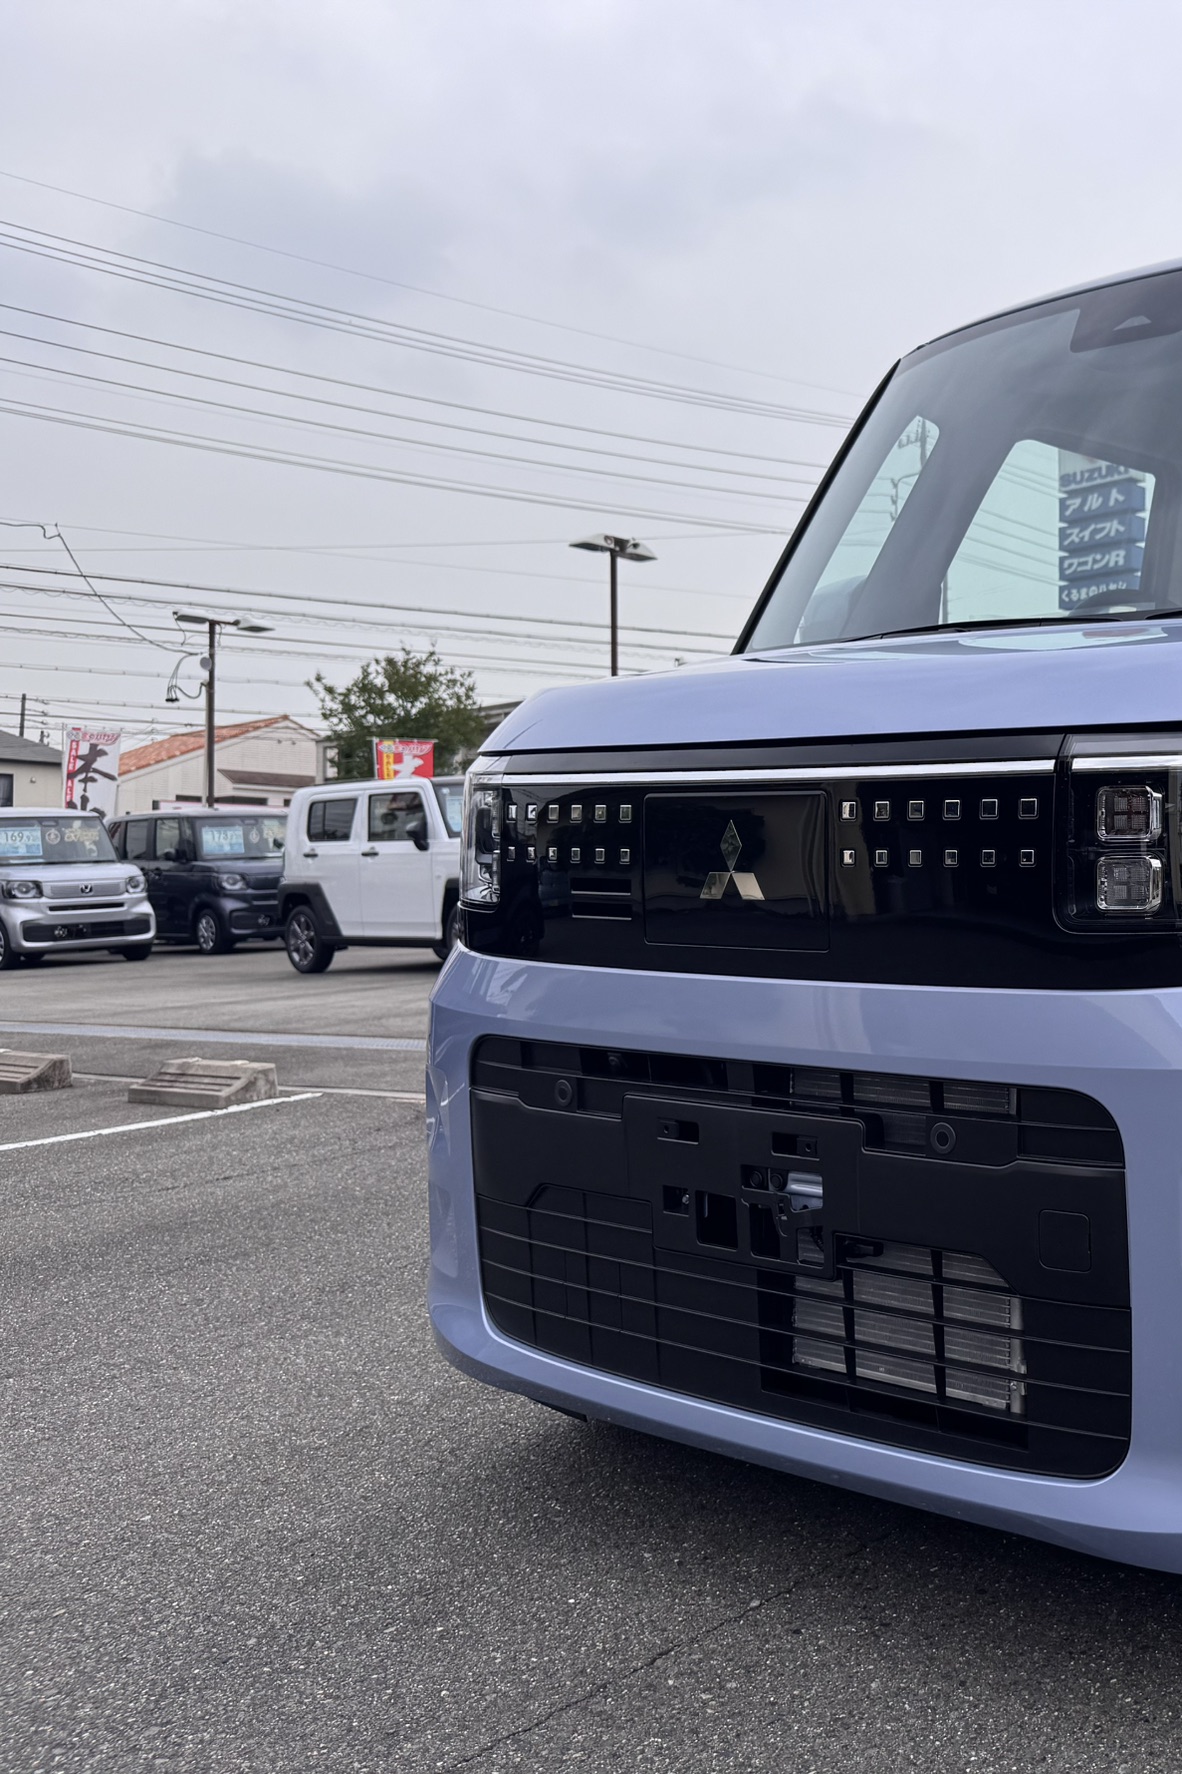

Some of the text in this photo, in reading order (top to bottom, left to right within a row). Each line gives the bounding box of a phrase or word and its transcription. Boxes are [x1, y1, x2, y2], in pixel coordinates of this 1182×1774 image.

[1064, 488, 1125, 516] アルト
[1063, 519, 1125, 546] スイフト
[1063, 550, 1126, 574] ワゴンR
